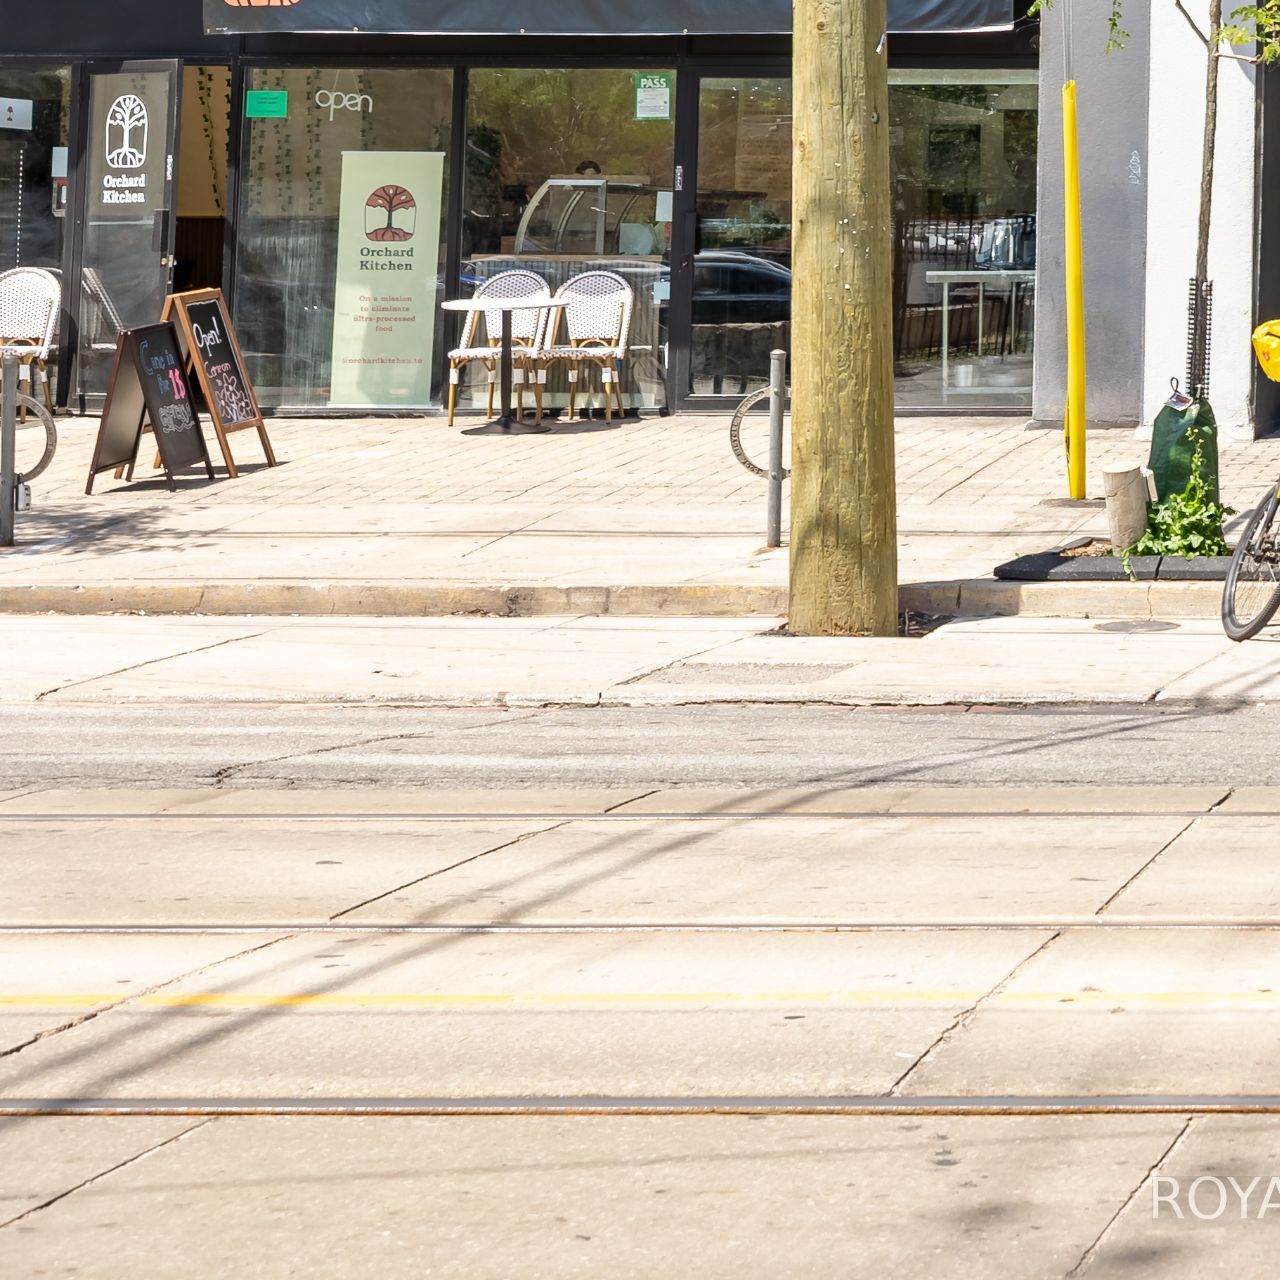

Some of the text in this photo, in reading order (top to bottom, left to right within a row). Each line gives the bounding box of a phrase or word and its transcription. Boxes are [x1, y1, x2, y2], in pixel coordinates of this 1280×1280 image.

[640, 78, 667, 89] PASS
[315, 89, 373, 122] open
[103, 174, 146, 188] Orchard
[102, 190, 146, 204] Kitchen
[360, 247, 415, 257] Orchard
[360, 260, 413, 271] Kitchen
[353, 315, 416, 323] ultra-processed
[193, 316, 222, 357] Open!
